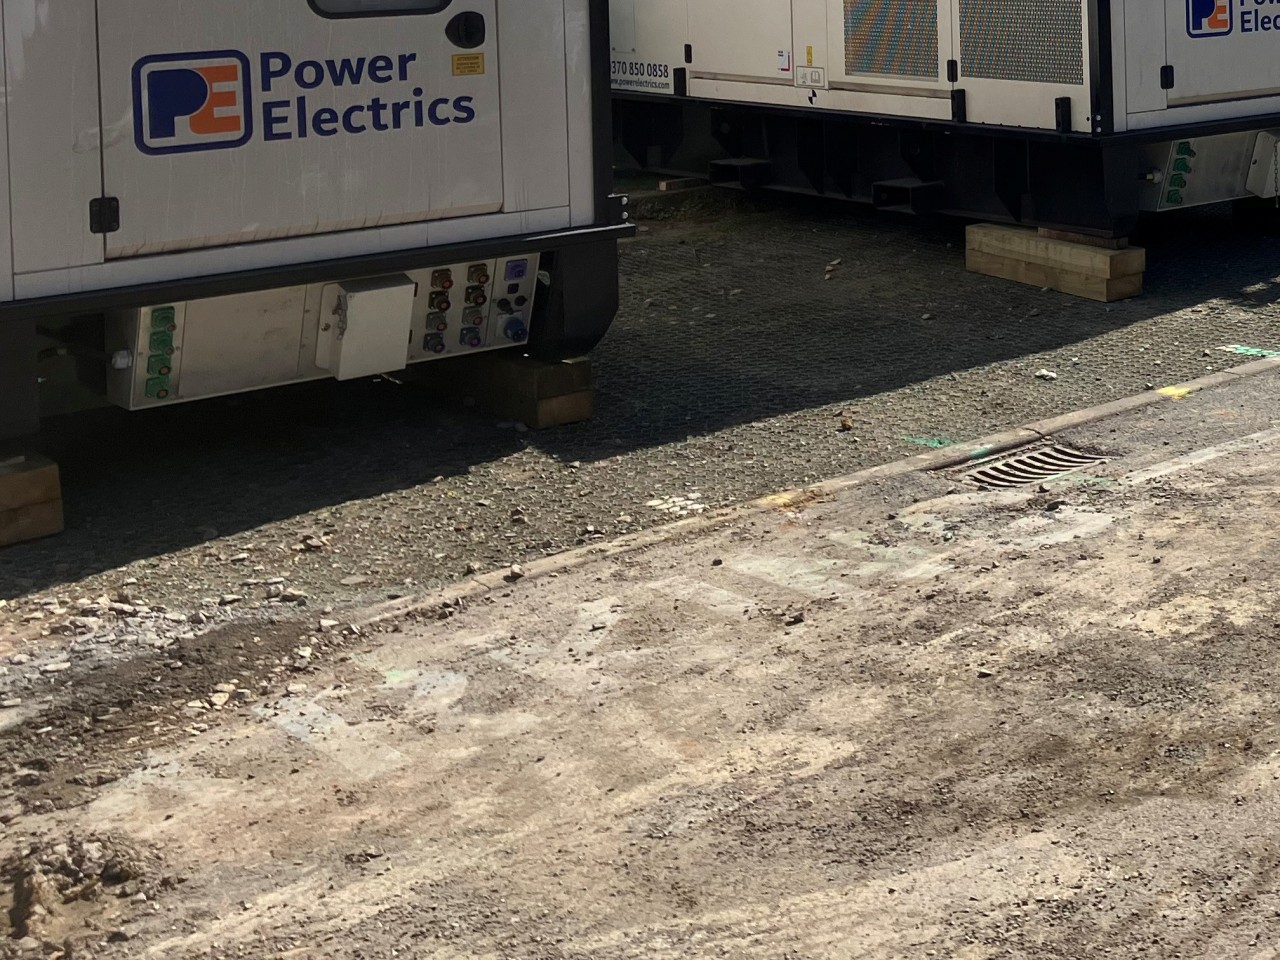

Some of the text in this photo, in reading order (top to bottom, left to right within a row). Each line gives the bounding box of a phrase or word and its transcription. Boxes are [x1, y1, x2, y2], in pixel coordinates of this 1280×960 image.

[260, 51, 417, 92] Power
[611, 60, 669, 79] 370 850 0858
[262, 87, 476, 142] Electrics
